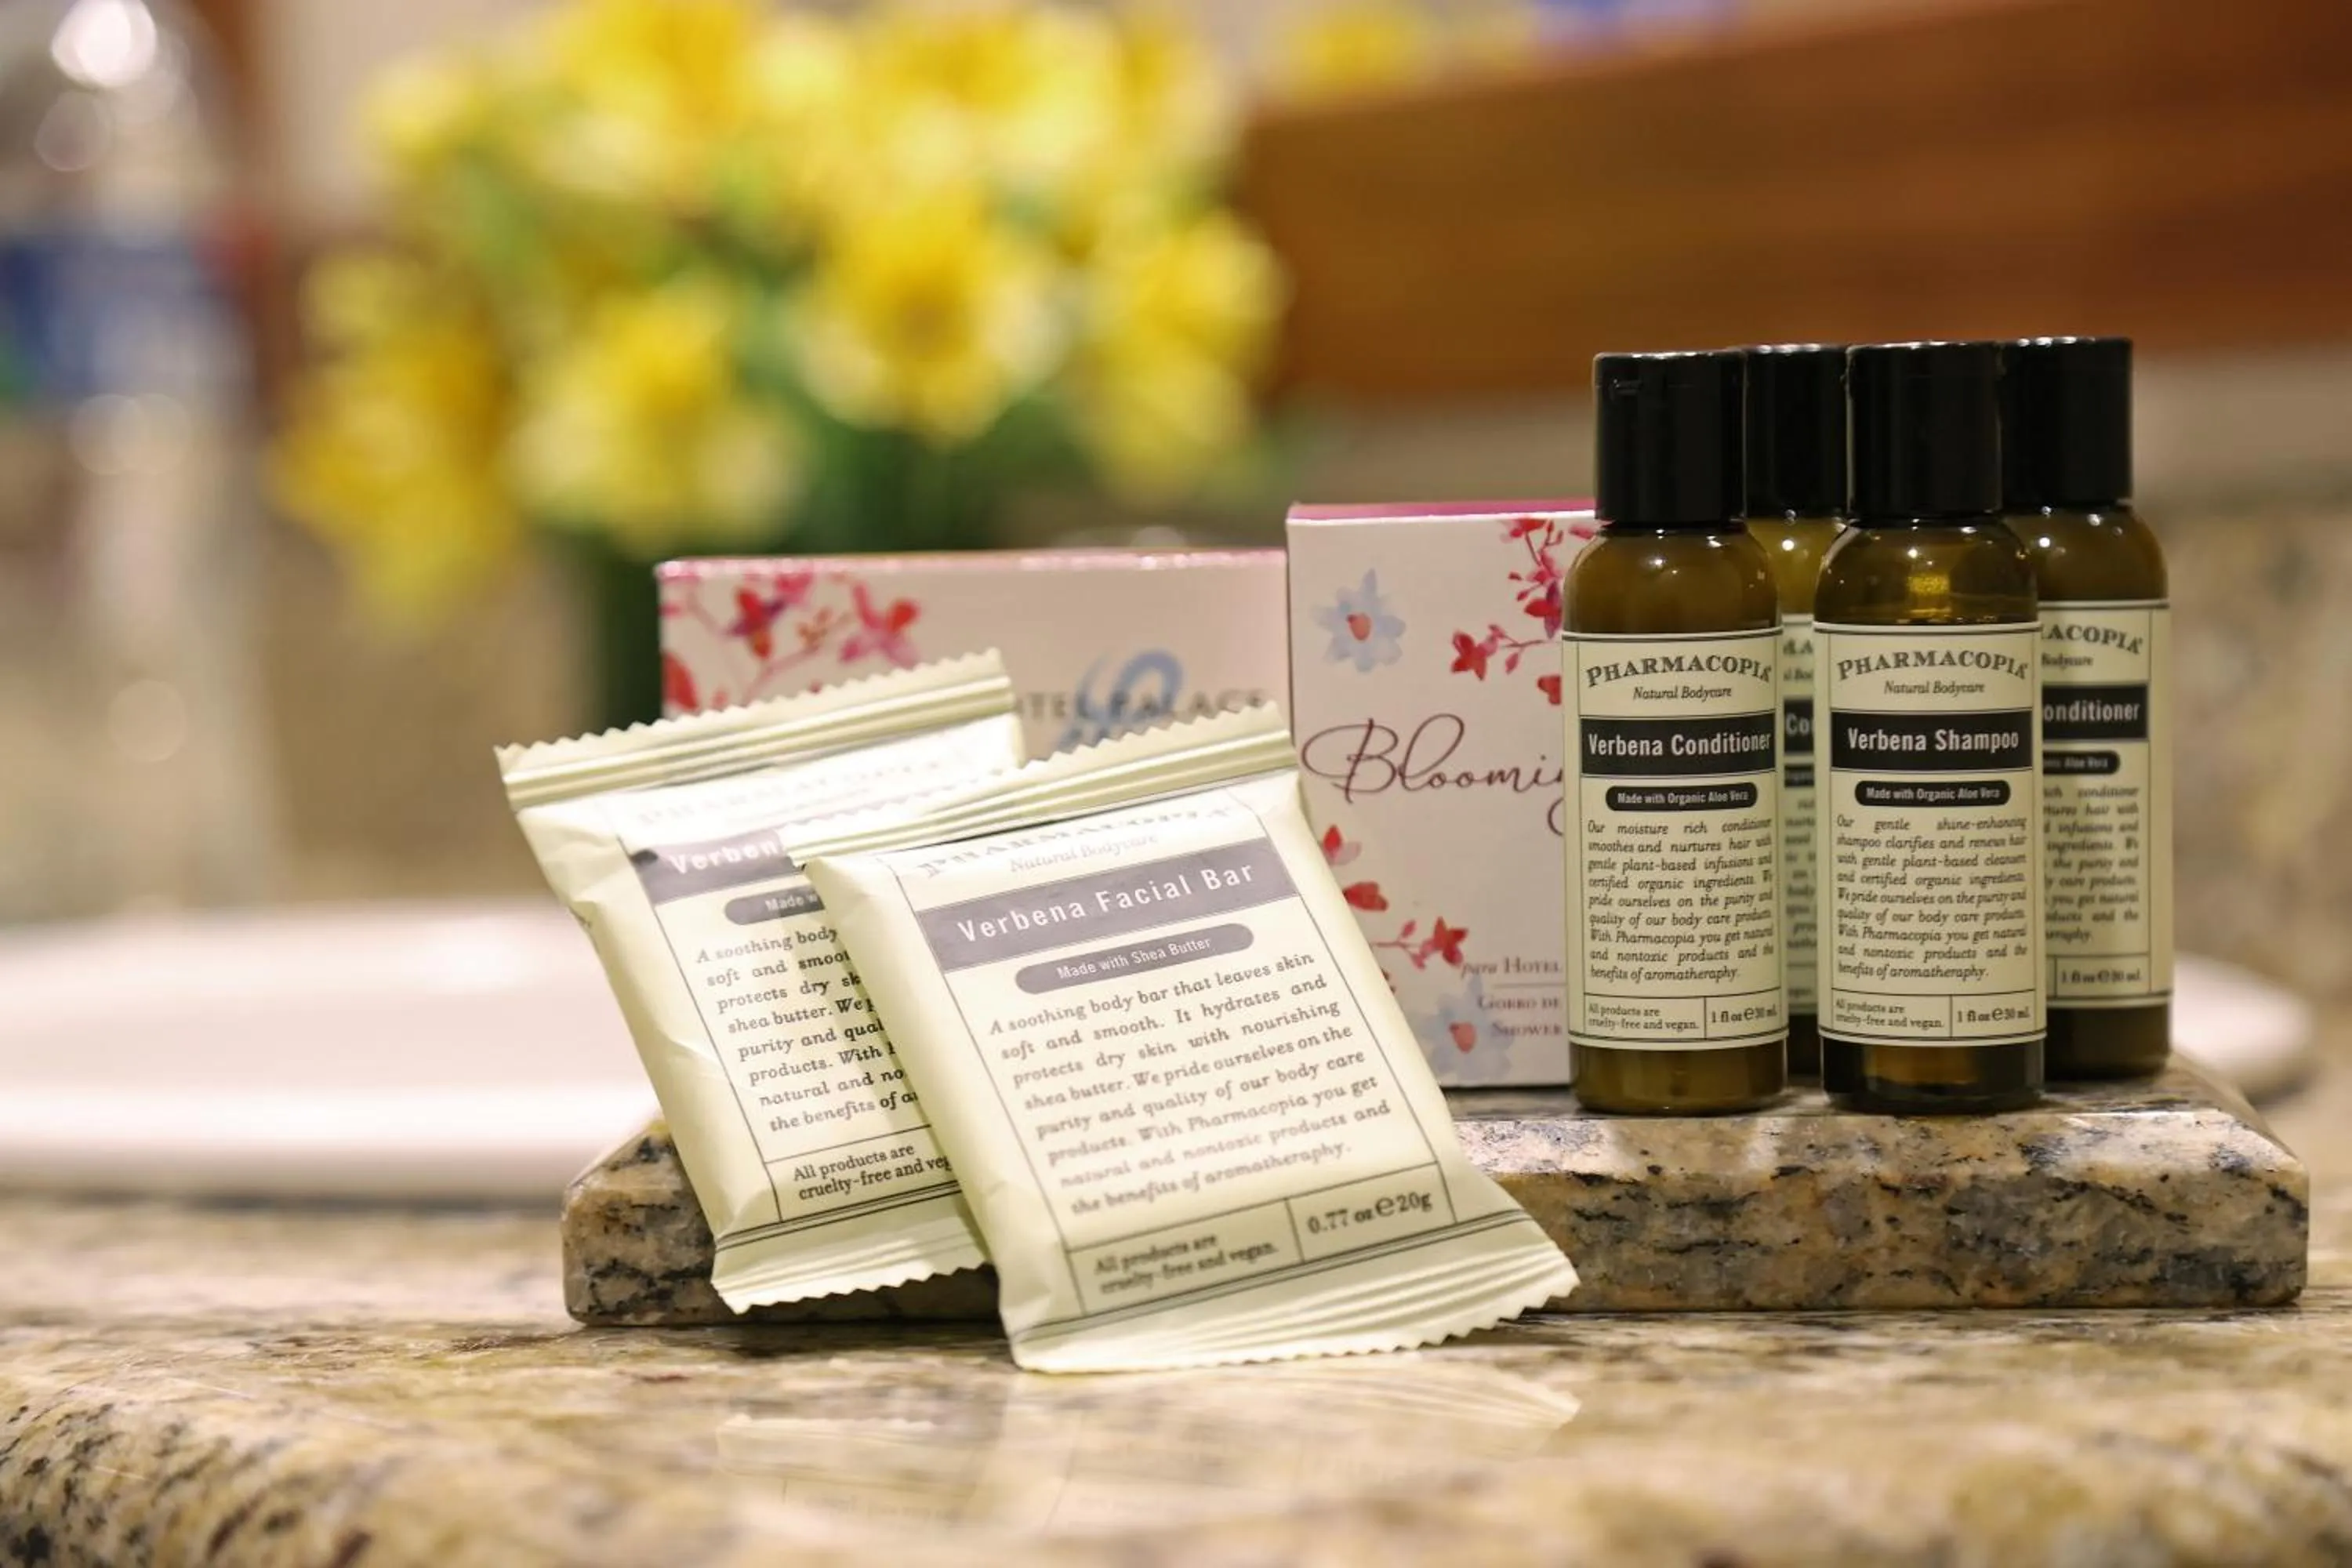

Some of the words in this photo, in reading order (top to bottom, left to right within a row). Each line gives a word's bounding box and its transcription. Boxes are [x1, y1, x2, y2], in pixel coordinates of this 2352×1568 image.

[2042, 624, 2144, 655] ACOPIA
[1586, 655, 1771, 688] PHARMACOPIA
[1837, 649, 2029, 681] PHARMACOPIA
[1634, 686, 1679, 700] Natural
[1682, 687, 1732, 702] Bodycare
[1884, 680, 1929, 695] Natural
[1933, 681, 1986, 698] Bodycare
[2043, 700, 2140, 722] onditioner
[1588, 734, 1664, 757] Verbena
[1671, 732, 1771, 756] Conditioner
[1848, 727, 1927, 751] Verbena
[1934, 728, 2019, 754] Shampoo
[1301, 713, 1563, 836] Bloomi
[1617, 793, 1642, 804] Made
[1646, 793, 1666, 804] with
[1668, 792, 1706, 806] Organic
[1708, 791, 1728, 802] Aloe
[1730, 790, 1749, 801] Vera
[1866, 787, 1893, 799] Made
[1893, 788, 1915, 800] with
[1916, 788, 1955, 801] Organic
[1958, 787, 1979, 798] Aloe
[1980, 786, 2000, 797] Vera
[1588, 820, 1605, 833] Our
[1617, 823, 1669, 836] moisture
[1684, 822, 1708, 834] rich
[1874, 818, 1910, 833] gentle
[670, 838, 779, 874] Verben
[1638, 840, 1662, 853] and
[1670, 840, 1722, 852] nurtures
[1886, 835, 1935, 851] clarifies
[1940, 837, 1964, 848] and
[1010, 847, 1078, 873] Natural
[1622, 858, 1697, 874] plant-based
[1902, 855, 1979, 871] plant-based
[1637, 877, 1684, 893] organic
[764, 893, 804, 911] Made
[957, 902, 1087, 942] Verbena
[1095, 875, 1192, 913] Facial
[1200, 862, 1254, 890] Bar
[1617, 895, 1671, 908] ourselves
[1671, 912, 1702, 929] body
[1918, 908, 1948, 924] body
[1616, 931, 1695, 947] Pharmacopia
[1862, 926, 1942, 944] Pharmacopia
[697, 949, 710, 964] A
[715, 935, 793, 960] soothing
[1057, 961, 1097, 979] Made
[1099, 954, 1130, 971] with
[1131, 947, 1167, 964] Shea
[1168, 937, 1211, 956] Butter
[1617, 950, 1668, 963] nontoxic
[1677, 948, 1730, 966] products
[1924, 946, 1977, 963] products
[706, 967, 741, 988] soft
[752, 960, 788, 978] and
[798, 950, 851, 971] smoo
[1890, 964, 1989, 981] aromatherapy.
[717, 988, 788, 1014] protects
[799, 979, 830, 996] dry
[842, 972, 862, 988] sk
[989, 1019, 1004, 1036] A
[1007, 1004, 1087, 1031] soothing
[1088, 995, 1134, 1013] body
[1137, 987, 1169, 1004] bar
[1173, 977, 1213, 996] that
[1214, 964, 1272, 987] leaves
[1276, 952, 1315, 973] skin
[728, 1014, 770, 1034] shea
[771, 1005, 833, 1025] butter.
[835, 997, 863, 1014] We
[1001, 1040, 1036, 1061] soft
[1046, 1029, 1083, 1049] and
[1092, 1016, 1165, 1040] smooth.
[1174, 1008, 1192, 1024] It
[1200, 989, 1281, 1020] hydrates
[1290, 974, 1327, 996] and
[738, 1035, 794, 1062] purity
[800, 1028, 837, 1047] and
[844, 1018, 885, 1043] qual
[1012, 1060, 1084, 1089] protects
[1095, 1051, 1126, 1069] dry
[1138, 1043, 1178, 1060] skin
[1188, 1028, 1230, 1049] with
[1241, 1000, 1341, 1036] nourishing
[749, 1057, 833, 1087] products.
[837, 1044, 883, 1065] With
[1024, 1091, 1067, 1111] shea
[1069, 1080, 1131, 1102] butter.
[1132, 1070, 1161, 1087] We
[1164, 1060, 1210, 1087] pride
[1214, 1040, 1295, 1072] ourselves
[1298, 1035, 1321, 1051] on
[1322, 1025, 1354, 1044] the
[759, 1081, 830, 1107] natural
[837, 1073, 874, 1092] and
[1036, 1115, 1092, 1141] purity
[1098, 1102, 1137, 1123] and
[1142, 1090, 1208, 1117] quality
[1214, 1080, 1233, 1101] of
[1240, 1075, 1271, 1092] our
[1275, 1062, 1320, 1083] body
[1326, 1051, 1367, 1071] care
[770, 1115, 800, 1132] the
[804, 1099, 876, 1127] benefits
[880, 1091, 897, 1111] of
[1138, 1122, 1183, 1142] With
[1187, 1094, 1308, 1131] Pharmacopia
[1312, 1087, 1347, 1108] you
[1350, 1076, 1378, 1098] get
[1060, 1160, 1132, 1189] natural
[1138, 1149, 1175, 1171] and
[1182, 1134, 1261, 1160] nontoxic
[1269, 1113, 1347, 1145] products
[1354, 1100, 1392, 1121] and
[793, 1163, 816, 1181] All
[818, 1149, 888, 1181] products
[890, 1144, 915, 1158] are
[799, 1170, 891, 1201] cruelty-free
[895, 1160, 924, 1177] and
[1071, 1199, 1101, 1215] the
[1104, 1180, 1178, 1207] benefits
[1181, 1171, 1200, 1192] of
[1204, 1142, 1352, 1185] aromatherapy.
[1306, 1209, 1349, 1235] 0.77
[1094, 1257, 1117, 1276] All
[1122, 1243, 1189, 1273] products
[1192, 1236, 1218, 1253] are
[1197, 1253, 1225, 1270] and
[1229, 1243, 1279, 1265] vegan.
